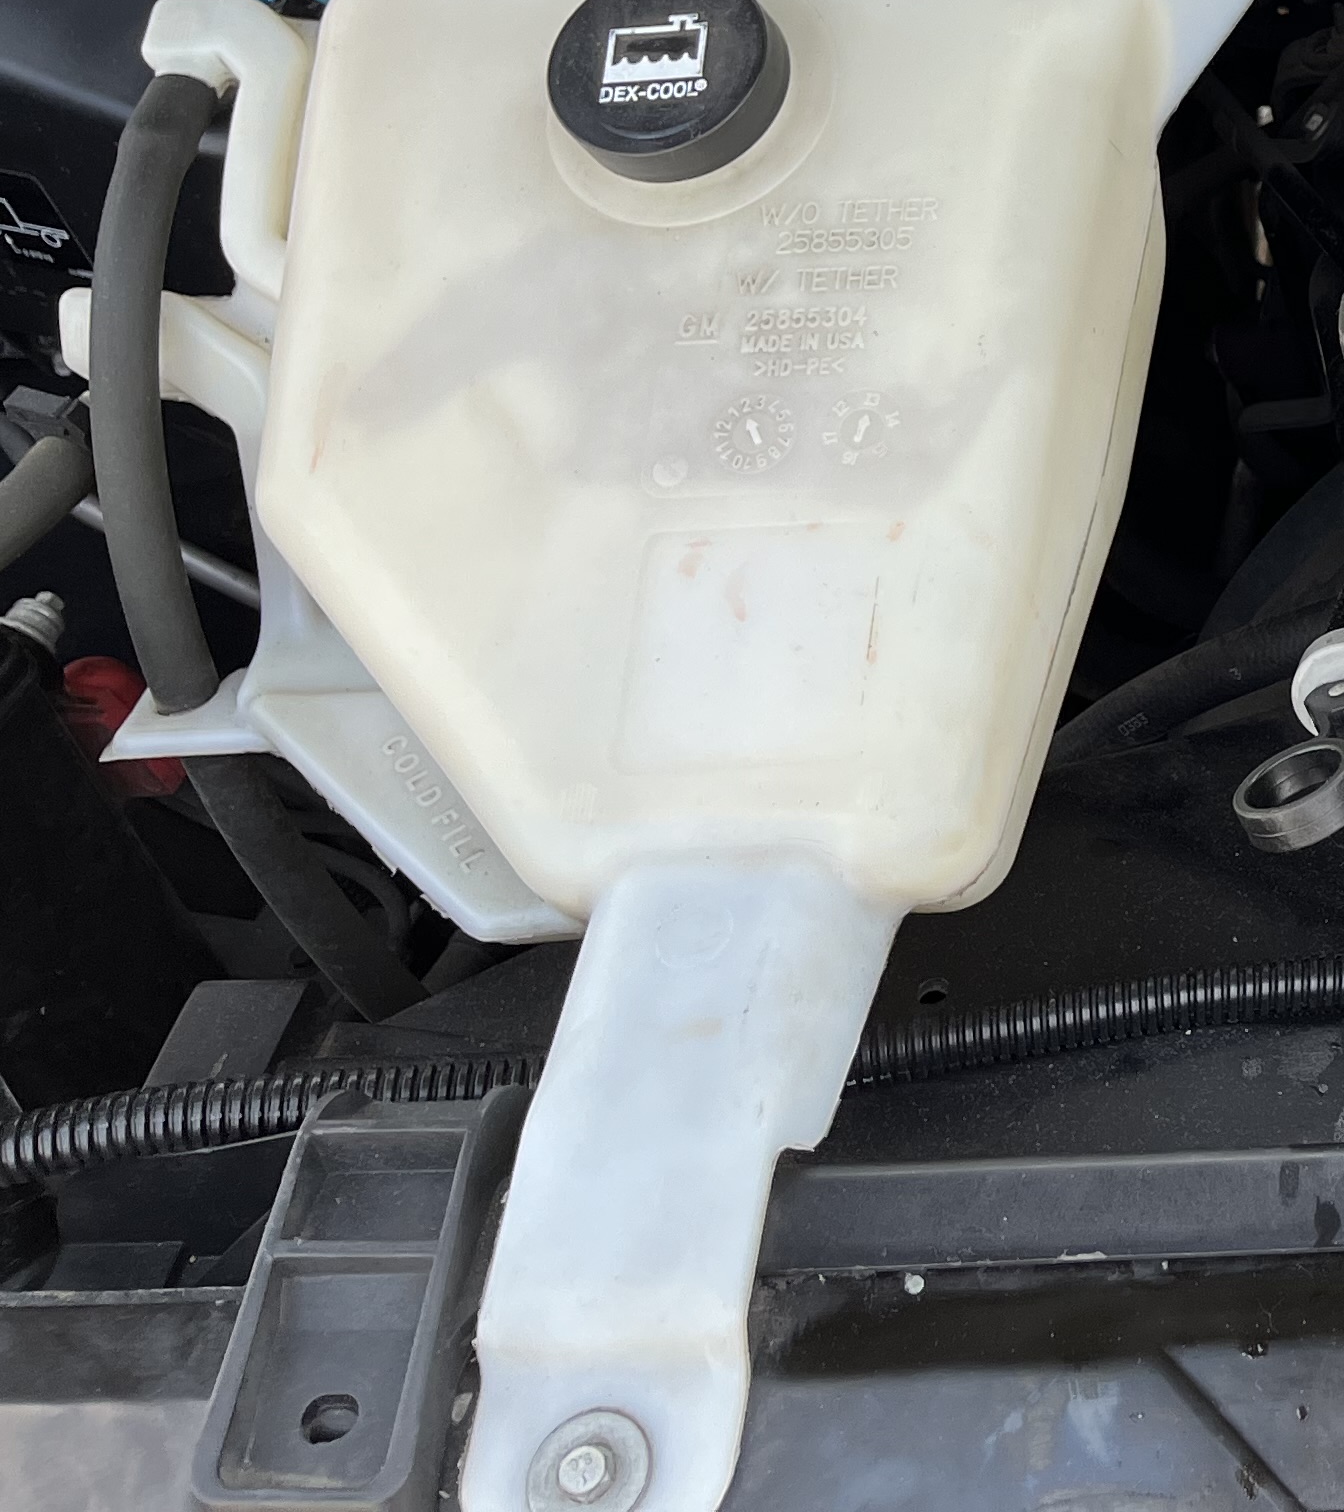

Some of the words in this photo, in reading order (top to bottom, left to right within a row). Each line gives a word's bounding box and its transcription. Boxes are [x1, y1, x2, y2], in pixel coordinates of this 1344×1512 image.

[598, 81, 699, 104] DEX-COOL
[760, 201, 819, 226] W/O
[838, 198, 938, 223] TETHER
[775, 227, 915, 255] 25855305
[736, 269, 780, 295] W/
[797, 265, 898, 292] TETHER
[678, 312, 720, 338] GM
[745, 306, 868, 332] 25855304
[740, 334, 793, 354] MADE
[800, 332, 819, 351] IN
[827, 332, 865, 350] USA
[382, 736, 441, 807] COLD
[431, 810, 485, 872] FILL
